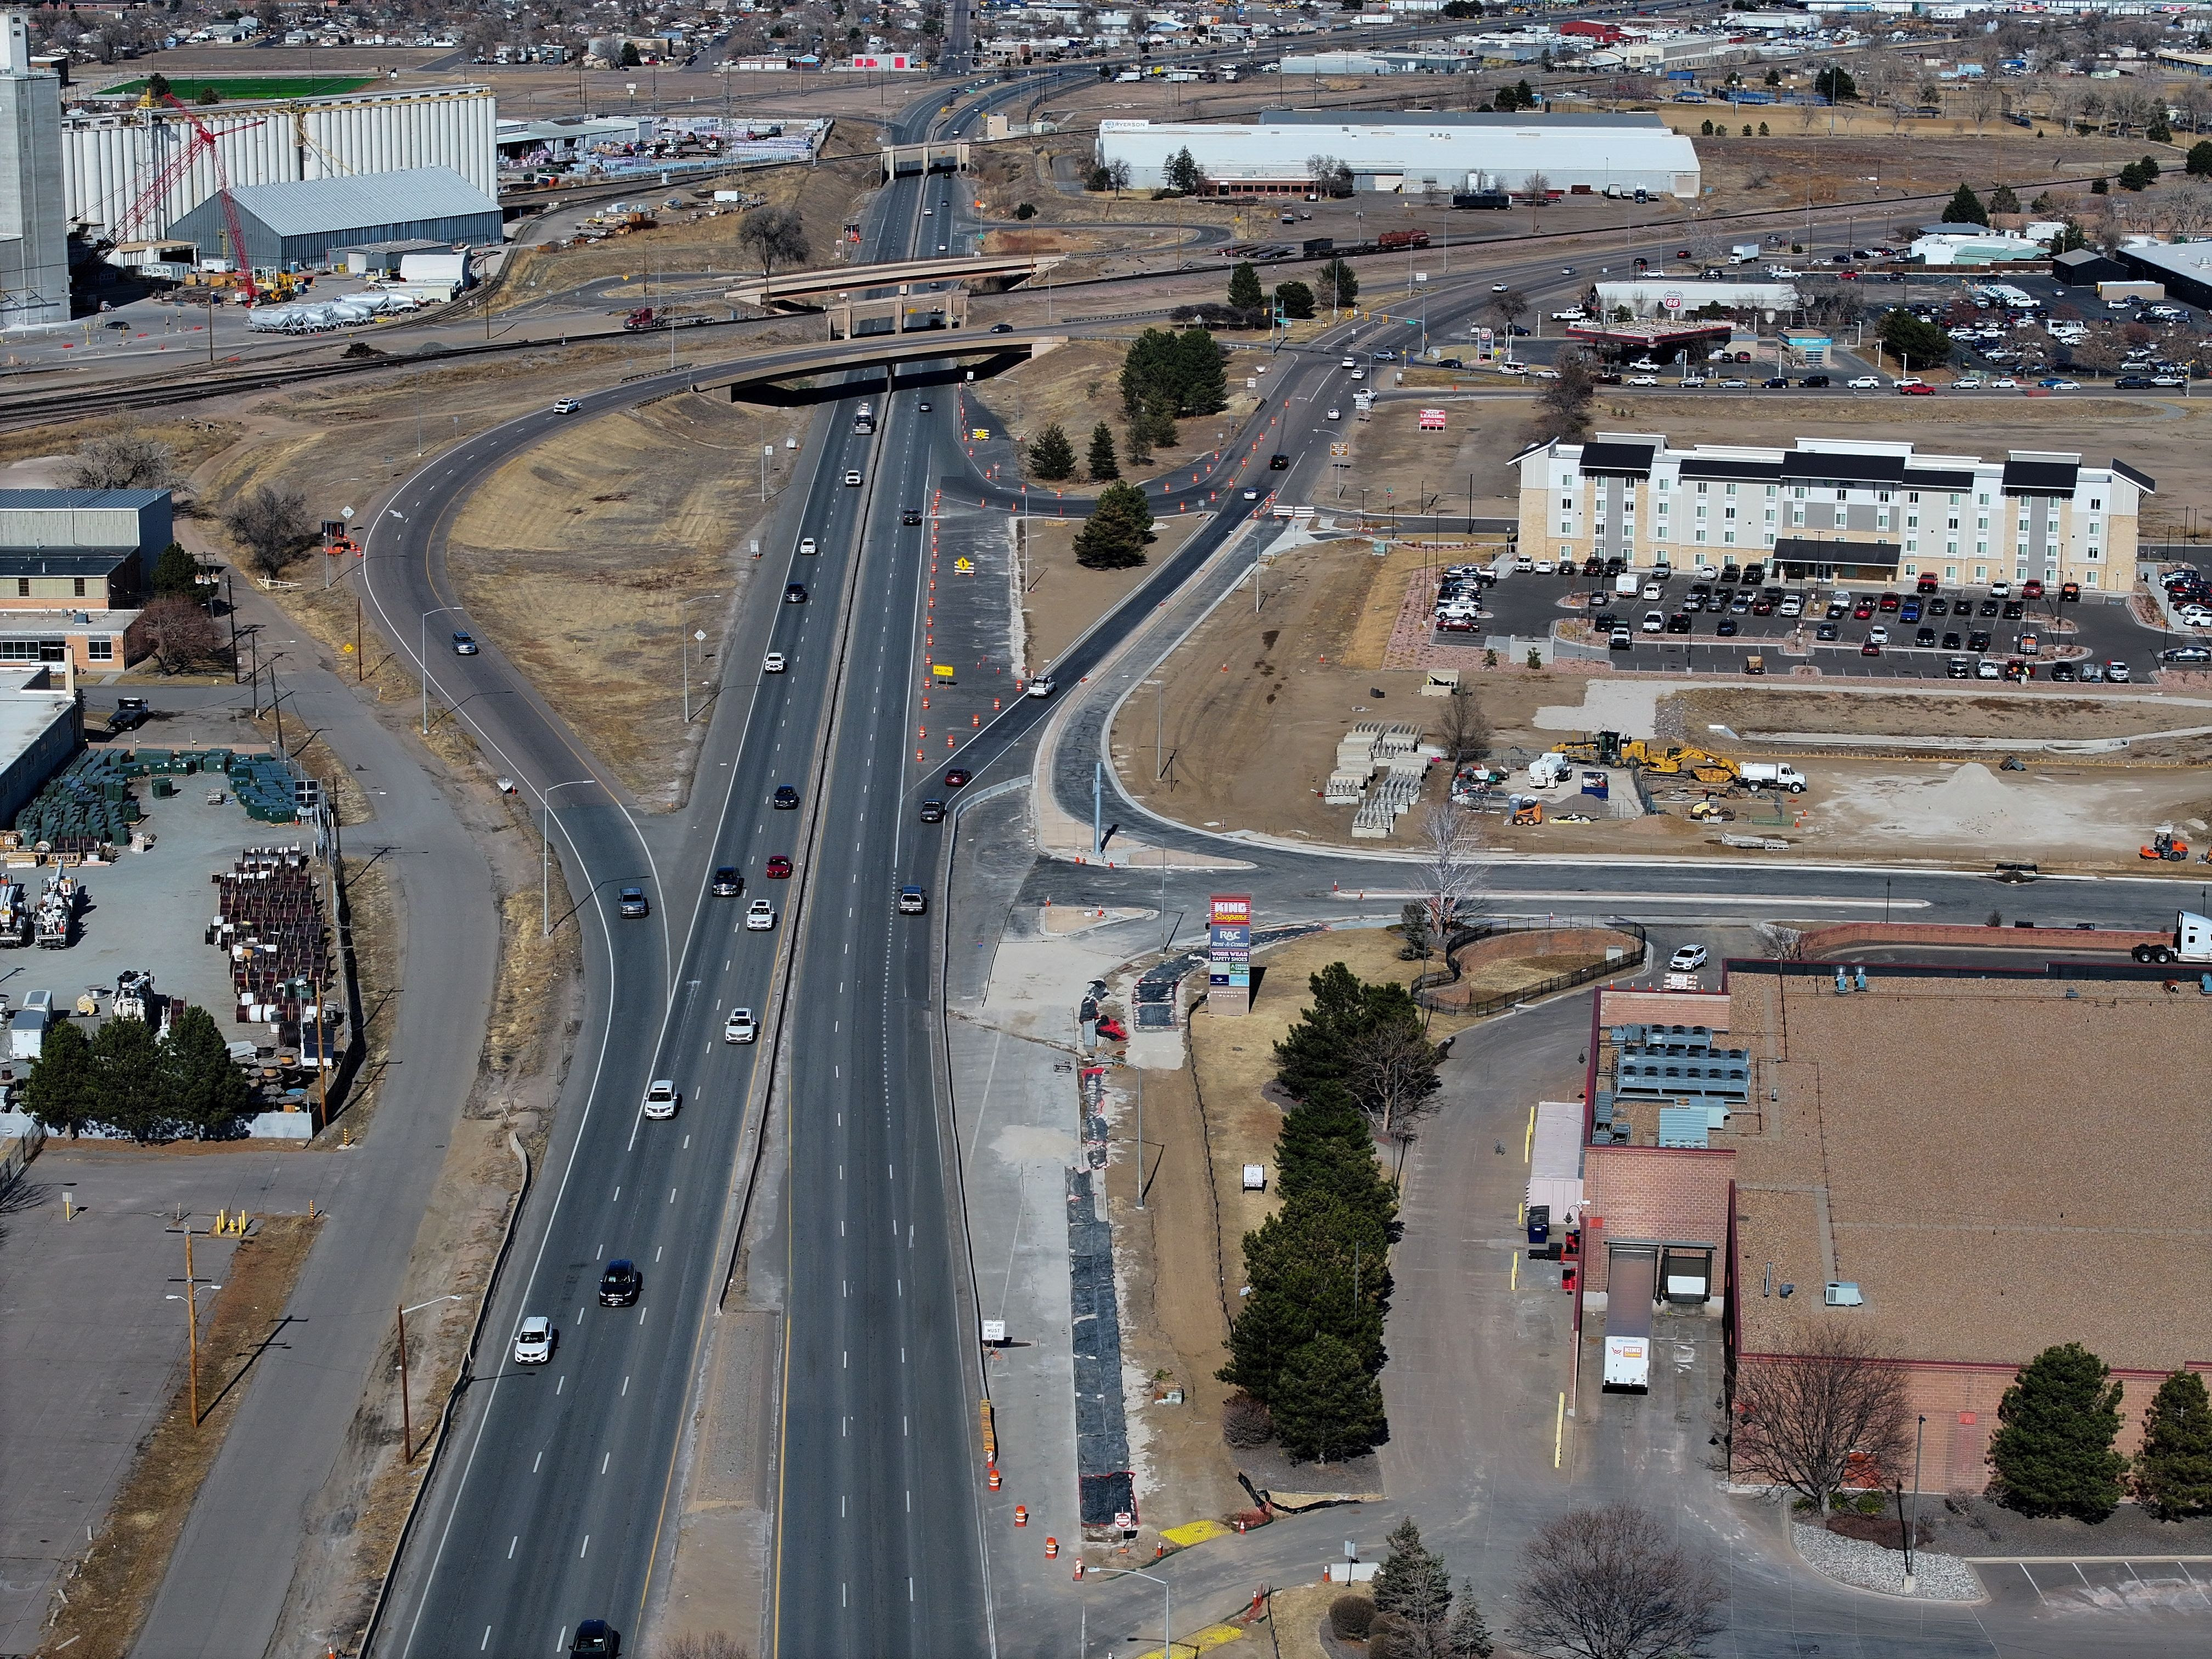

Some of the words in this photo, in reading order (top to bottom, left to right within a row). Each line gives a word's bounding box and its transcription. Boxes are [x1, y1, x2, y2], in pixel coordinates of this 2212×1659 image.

[1215, 903, 1246, 912] KING
[1214, 912, 1247, 922] Soopers
[1220, 931, 1240, 940] RAC
